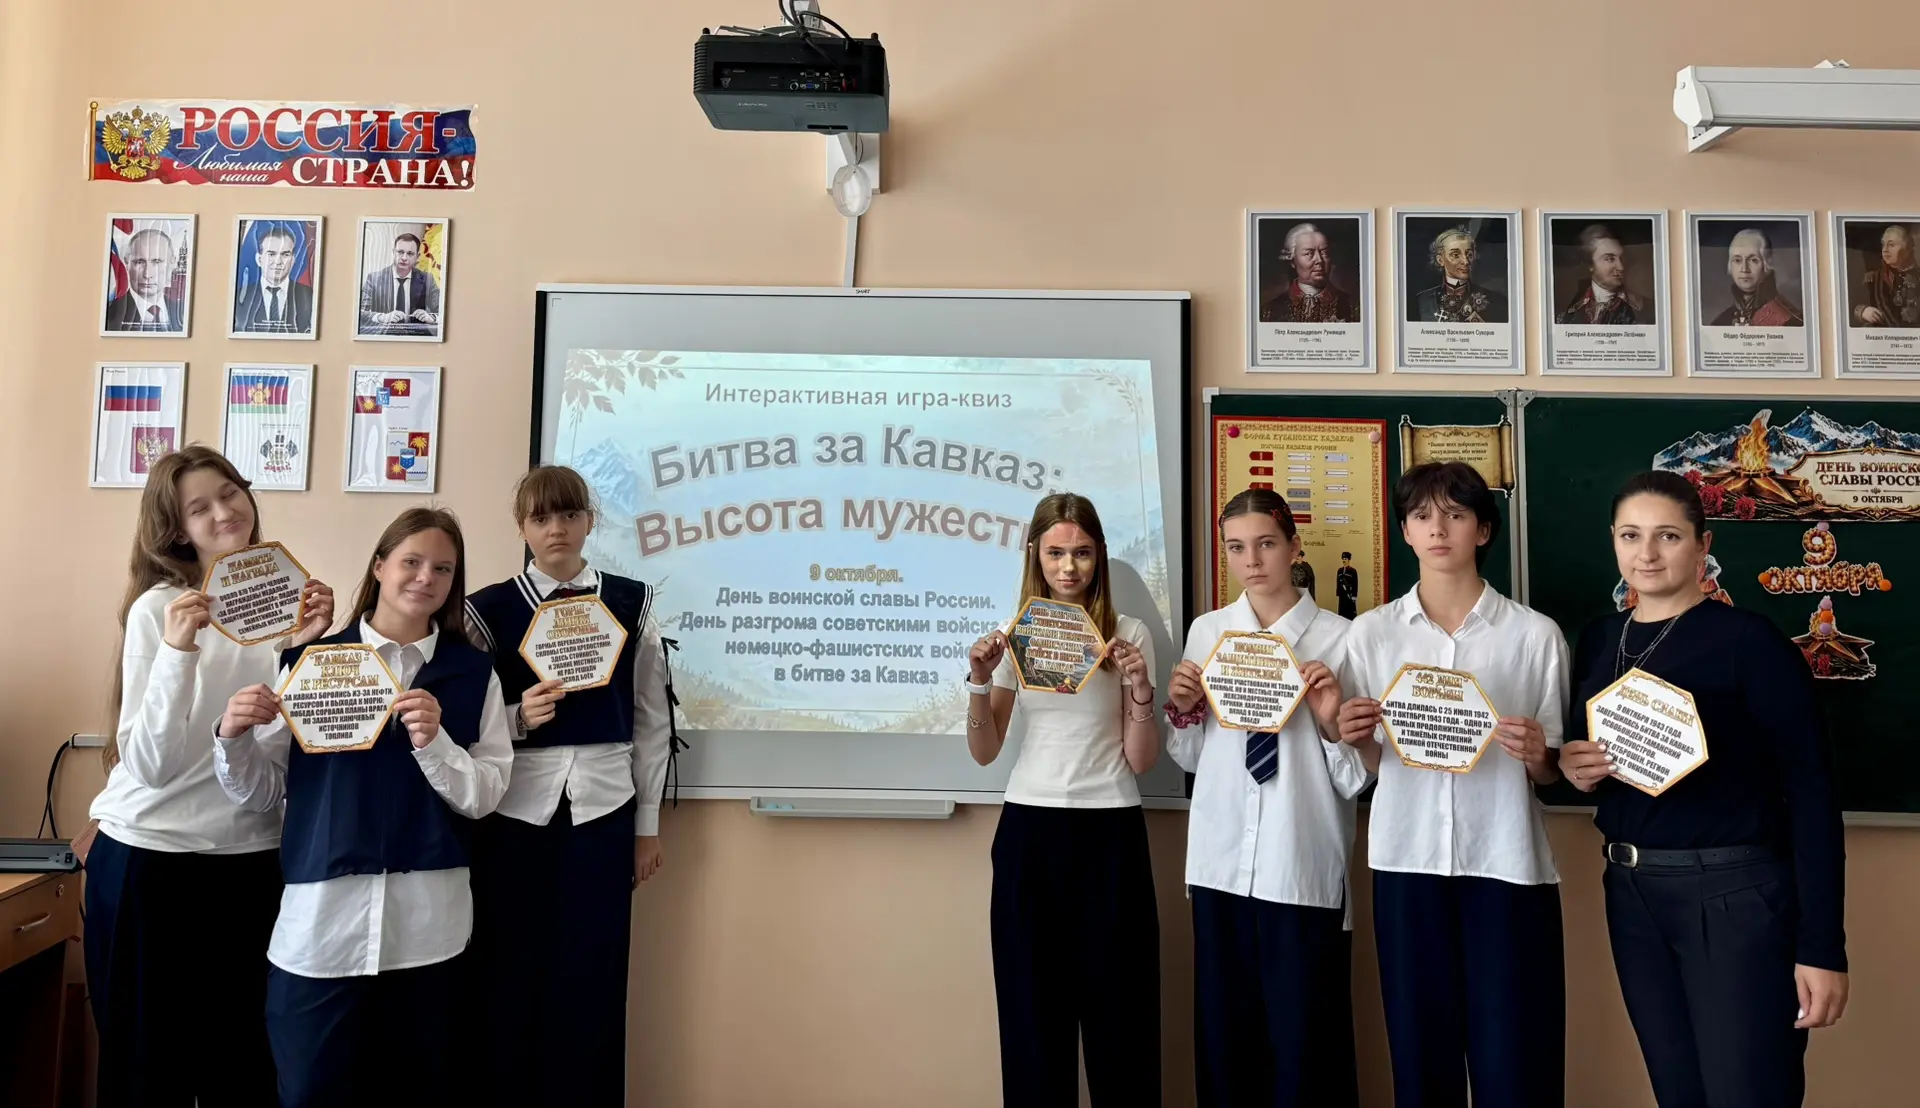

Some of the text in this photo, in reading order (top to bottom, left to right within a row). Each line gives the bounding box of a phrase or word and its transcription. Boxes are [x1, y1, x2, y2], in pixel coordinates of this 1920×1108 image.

[177, 107, 456, 153] РОССИЯ-
[173, 143, 284, 172] Любимая
[220, 172, 269, 184] наша
[292, 158, 471, 187] СТРАНА!
[1421, 328, 1447, 336] Александр
[705, 383, 1012, 410] Интерактивная игра-квиз
[651, 427, 1062, 494] Битва за Кавказ:
[1815, 461, 1856, 474] ДЕНЬ
[1819, 474, 1873, 486] СЛАВЫ
[1852, 495, 1903, 504] 9 ОКТЯБРЯ
[636, 499, 823, 557] Высота
[1802, 526, 1837, 567] 9
[809, 564, 904, 586] 9 октября.
[715, 587, 996, 610] День воинской славы России.
[679, 611, 727, 631] День
[731, 616, 817, 634] разгрома
[823, 617, 930, 633] советскими
[725, 639, 924, 659] немецко-фашистских
[315, 653, 361, 666] КАВКАЗ
[321, 664, 359, 678] КЛЮЧ
[774, 664, 939, 685] в битве за Кавказ
[1416, 672, 1434, 685] 442
[300, 675, 378, 691] К РЕСУРСАМ
[319, 691, 351, 699] БОРОЛИСЬ
[352, 689, 370, 697] ИЗ-ЗА
[1413, 686, 1463, 701] БОРЬБЫ
[293, 701, 324, 709] РЕСУРСОВ
[316, 708, 344, 716] СОРВАЛА
[345, 706, 368, 714] ПЛАНЫ
[1386, 701, 1406, 709] БИТВА
[1407, 703, 1437, 713] ДЛИЛАСЬ
[1444, 707, 1452, 715] 25
[1454, 709, 1472, 717] ИЮЛЯ
[1474, 711, 1489, 719] 1942
[1616, 685, 1695, 727] ДЕНЬ СЛАВЫ
[312, 716, 338, 724] ЗАХВАТУ
[340, 714, 375, 722] КЛЮЧЕВЫХ
[1398, 711, 1425, 720] ОКТЯБРЯ
[1427, 715, 1442, 723] 1943
[1443, 717, 1459, 725] ГОДА
[1464, 719, 1482, 727] ОДНО
[1597, 706, 1639, 729] ЗАВЕРШИЛАСЬ
[1640, 725, 1660, 739] БИТВА
[1660, 734, 1669, 743] ЗА
[1622, 707, 1649, 723] ОКТЯБРЯ
[1650, 719, 1665, 731] 1943
[1665, 726, 1681, 738] ГОДА
[319, 723, 359, 732] ИСТОЧНИКОВ
[1392, 719, 1482, 736] САМЫХ ПРОДОЛЖИТЕЛЬНЫХ
[325, 732, 352, 740] ТОПЛИВА
[1407, 730, 1437, 739] ТЯЖЁЛЫХ
[1439, 734, 1472, 743] СРАЖЕНИЙ
[1602, 719, 1643, 741] ОСВОБОЖДЁН
[1644, 737, 1681, 759] ТАМАНСКИЙ
[1397, 737, 1477, 753] ВЕЛИКОЙ ОТЕЧЕСТВЕННОЙ
[1425, 750, 1448, 759] ВОЙНЫ
[1618, 757, 1664, 783] ОТ ОККУПАЦИИ
[1646, 760, 1670, 775] РЕГИОН
